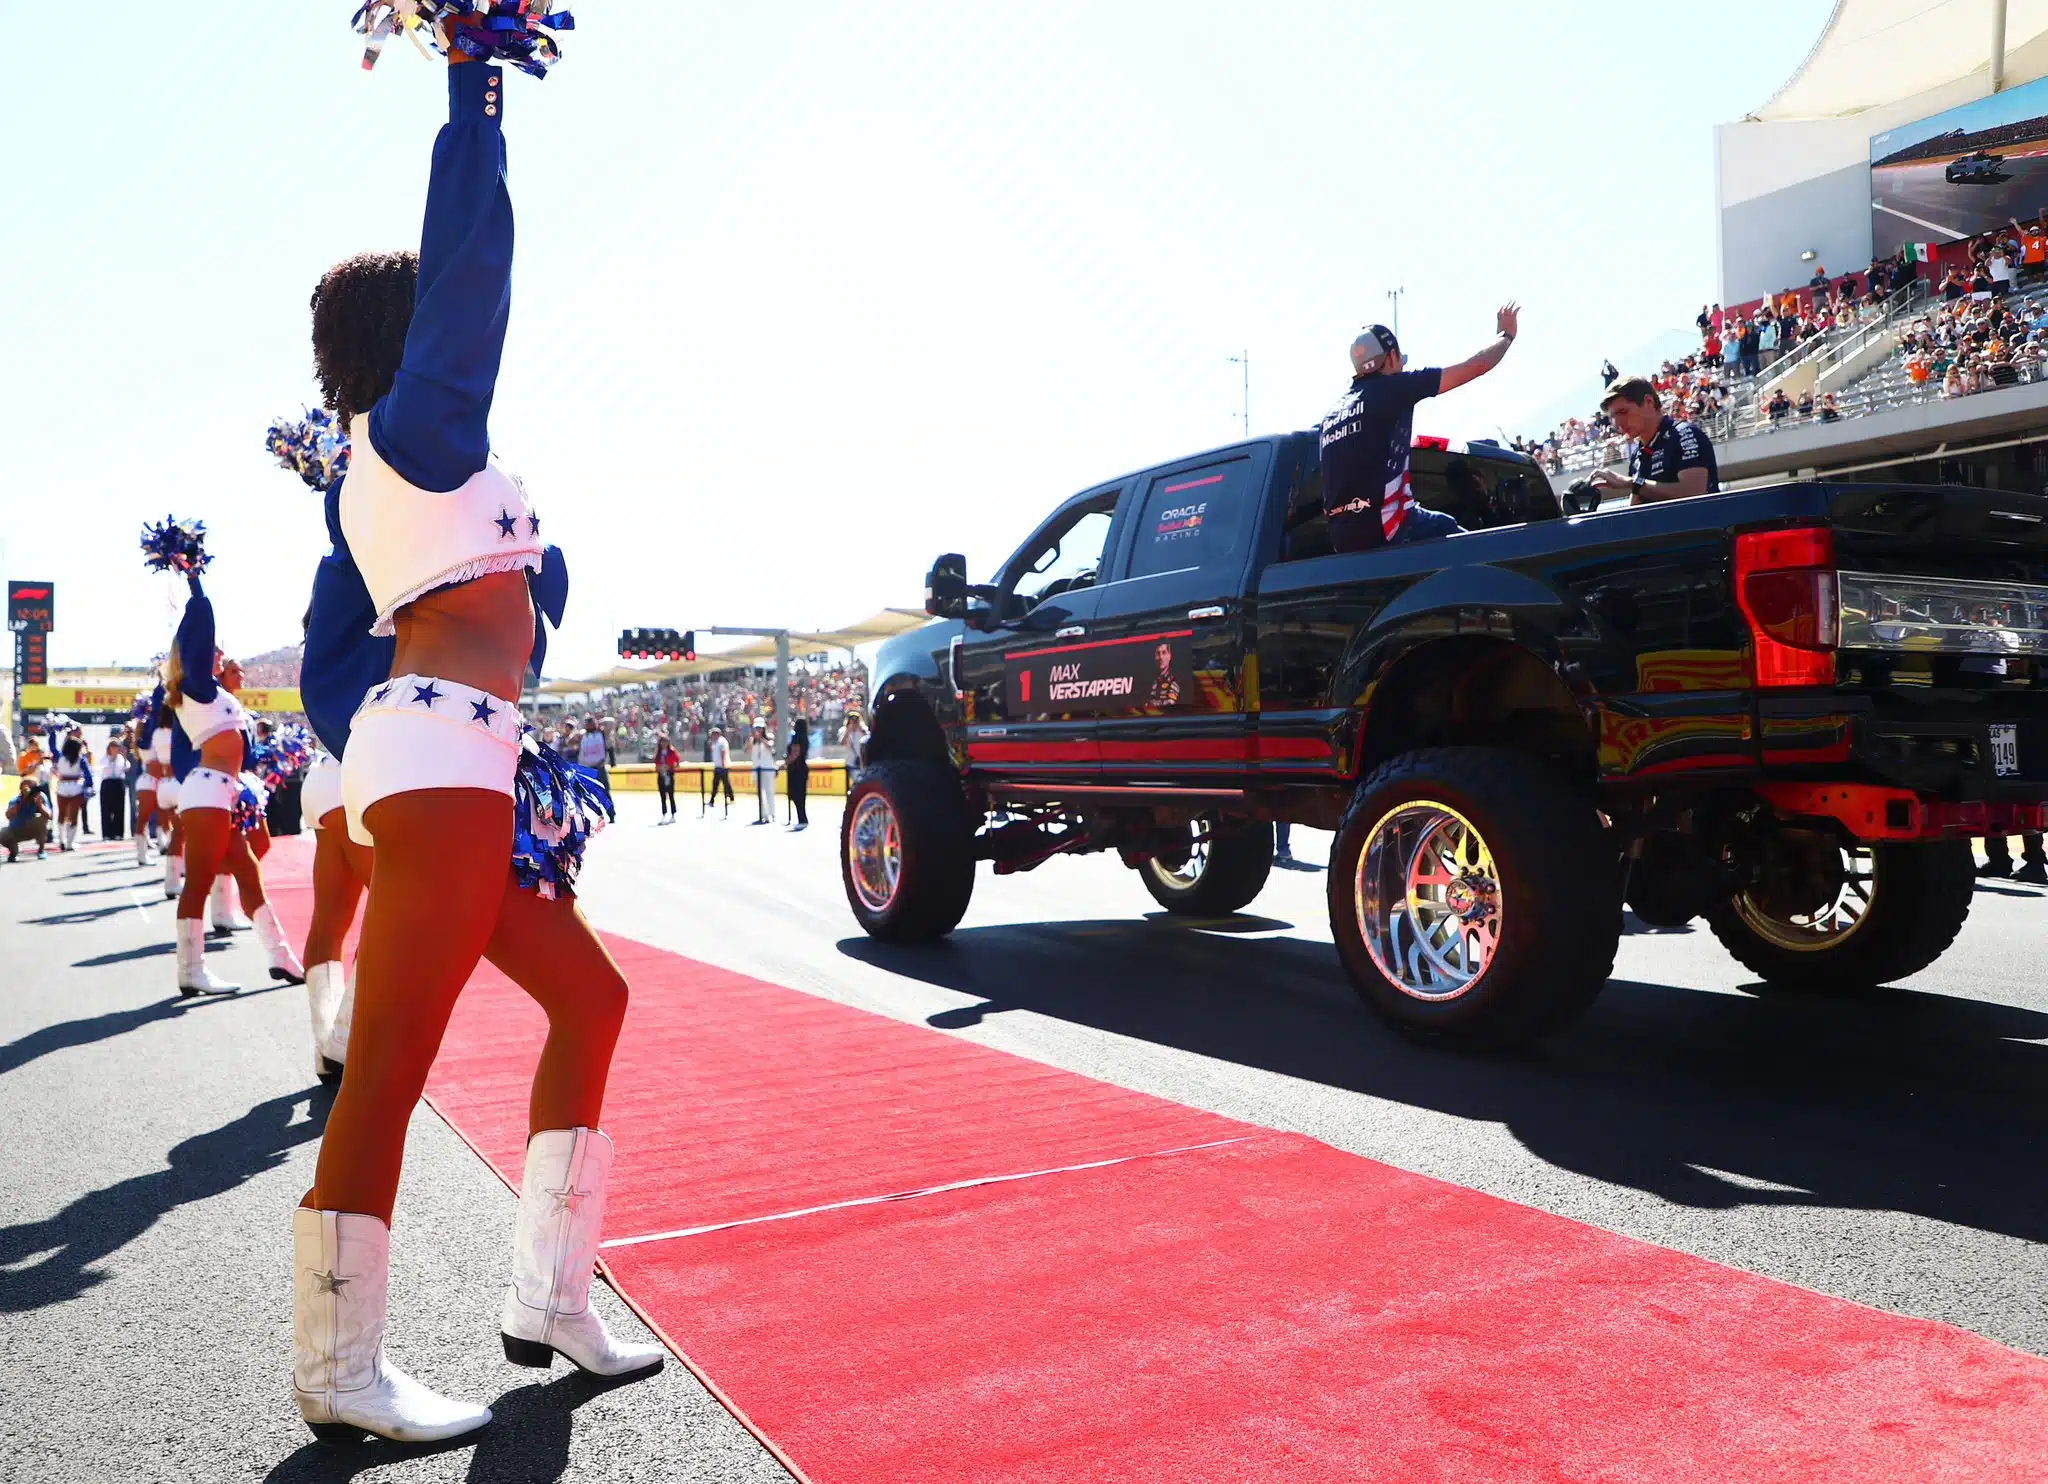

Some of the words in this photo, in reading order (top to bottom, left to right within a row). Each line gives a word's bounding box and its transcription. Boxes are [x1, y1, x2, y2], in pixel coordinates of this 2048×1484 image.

[2031, 240, 2040, 250] 4
[1340, 401, 1364, 422] Bull
[1322, 424, 1347, 448] Mobil
[1161, 502, 1207, 520] ORACLE
[1155, 529, 1200, 542] RACING
[1049, 663, 1080, 682] MAX
[1019, 670, 1031, 703] 1
[1049, 677, 1134, 701] VERSTAPPEN
